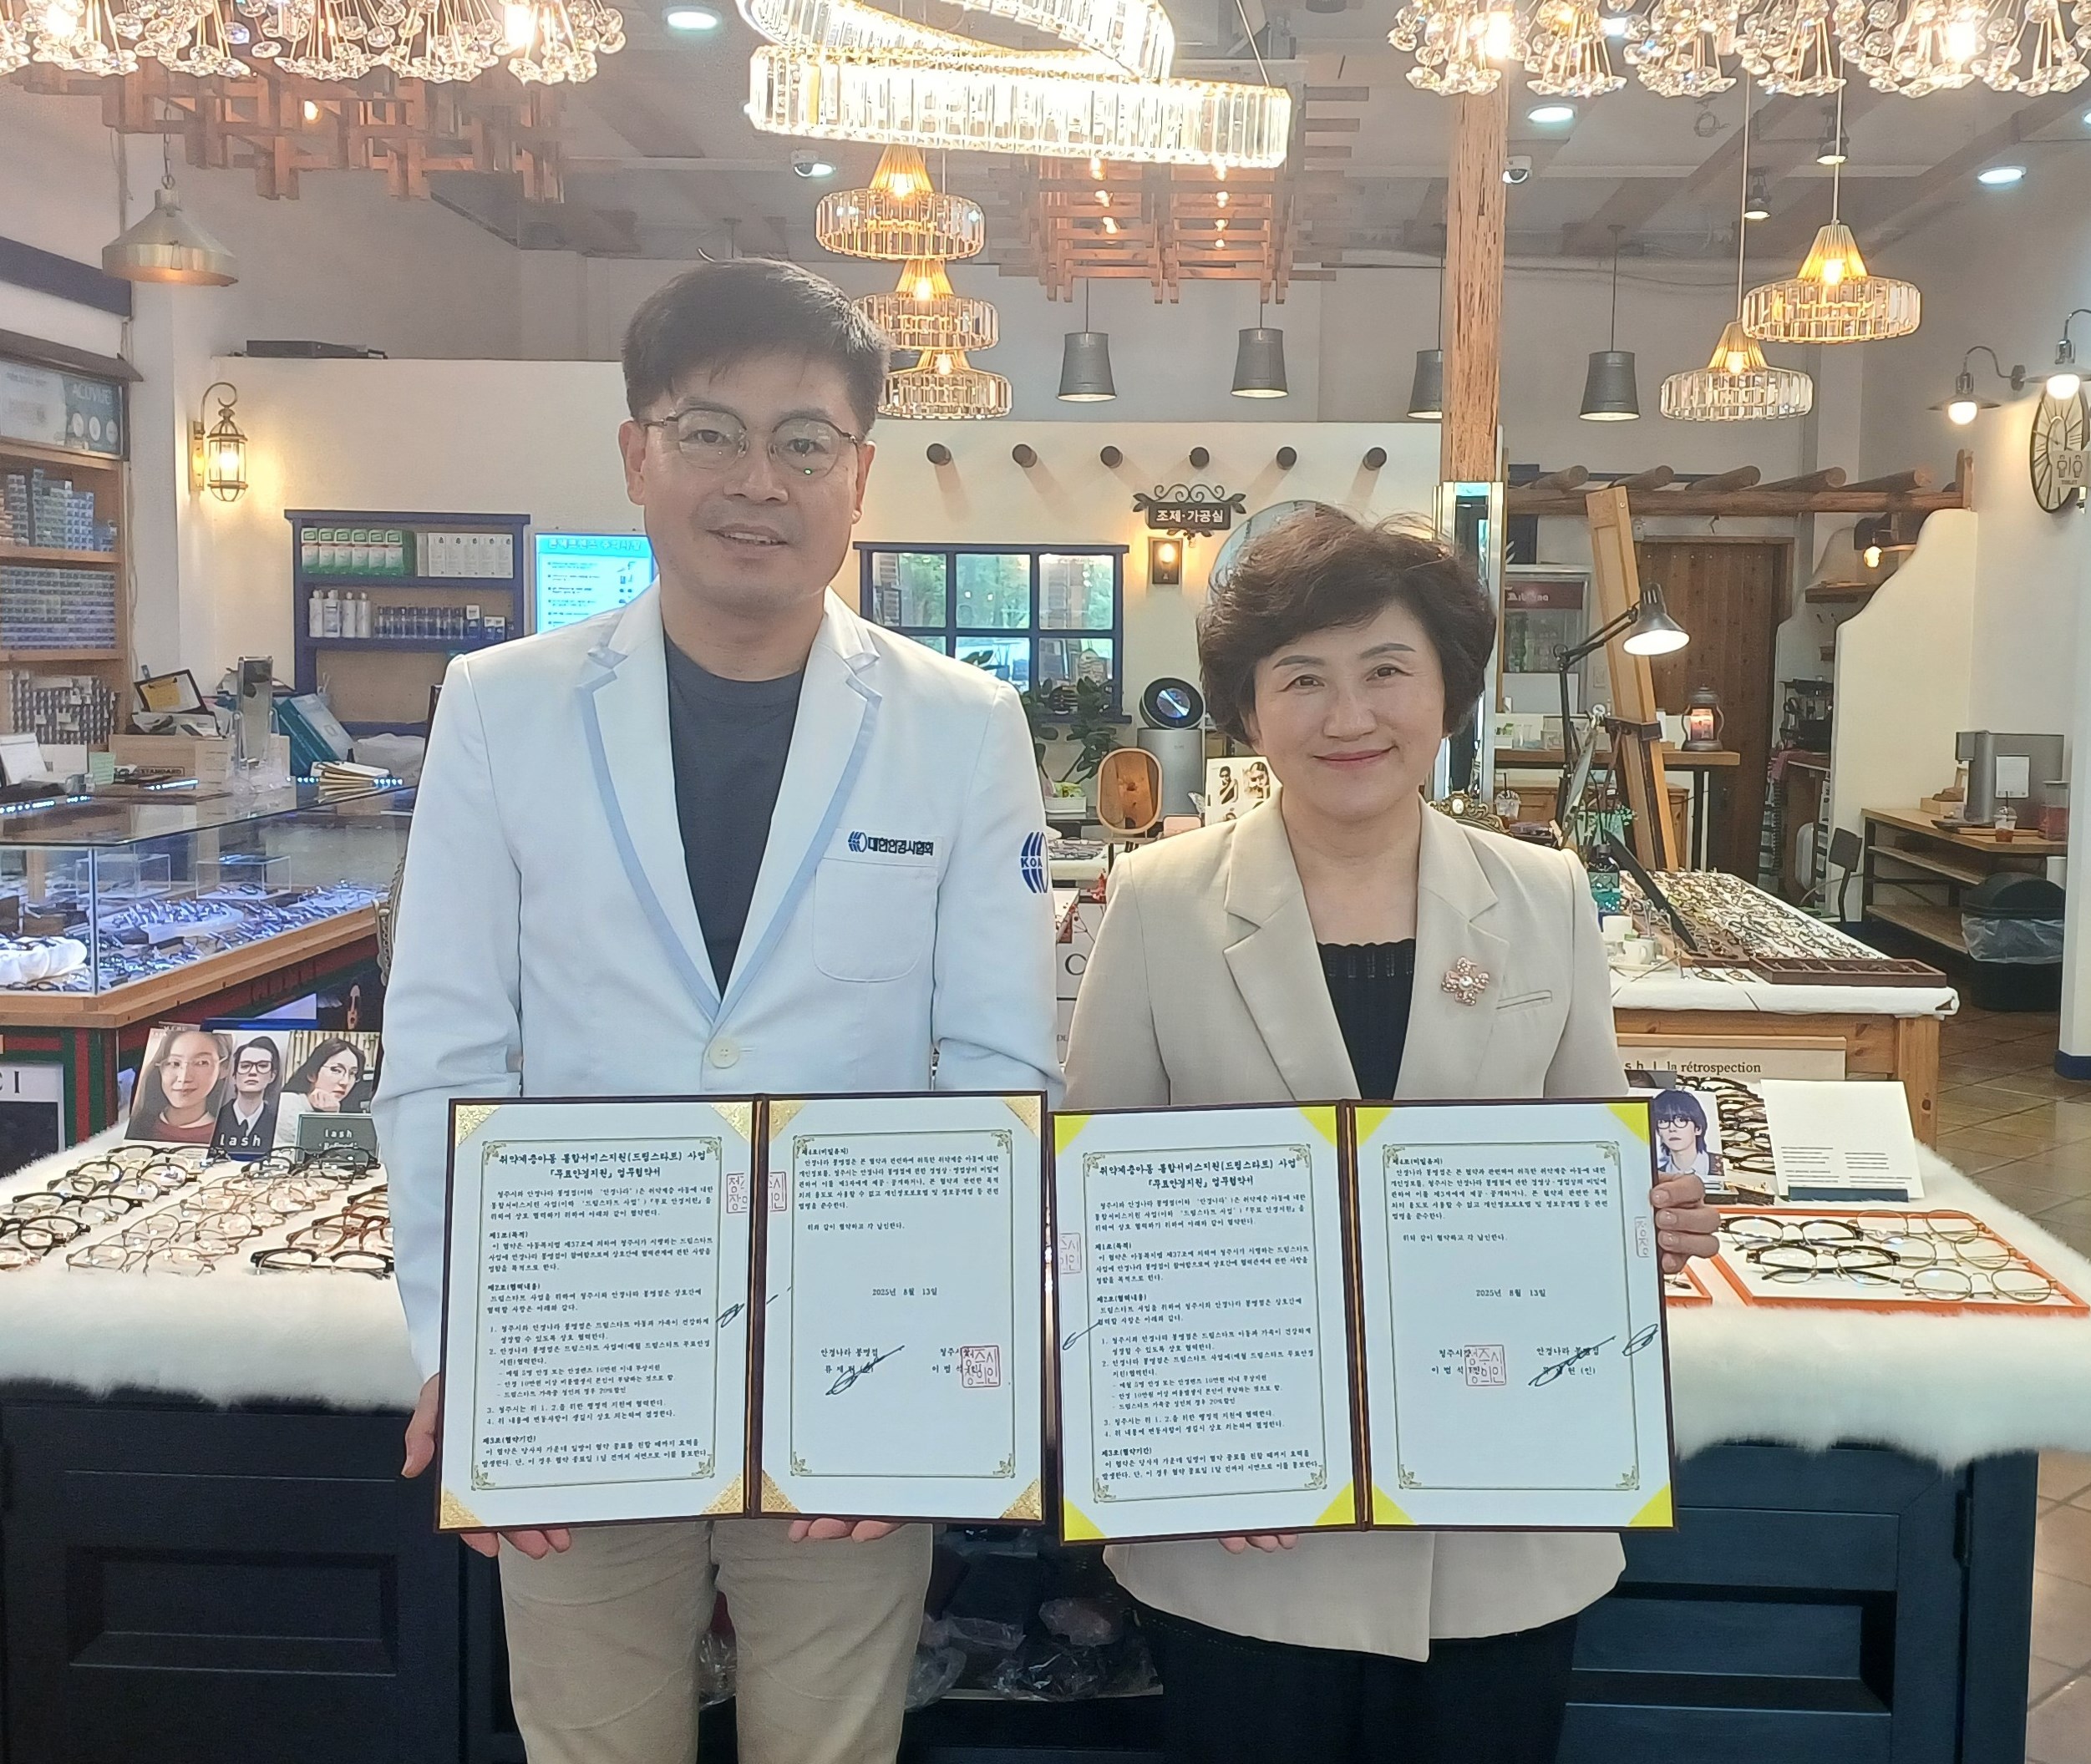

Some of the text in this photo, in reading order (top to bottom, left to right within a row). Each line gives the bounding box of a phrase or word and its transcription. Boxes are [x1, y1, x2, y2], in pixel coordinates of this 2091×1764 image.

[1155, 509, 1224, 523] 조제·가공실
[867, 836, 934, 856] 대한안경사협회
[1020, 857, 1043, 868] KOA
[1681, 1062, 1761, 1075] rétrospection
[325, 1128, 353, 1138] lash
[220, 1133, 261, 1147] lash
[871, 1286, 937, 1296] 2025년 8월 13일
[1475, 1288, 1545, 1297] 2025년 8월 13일
[1536, 1346, 1570, 1356] 안경나라
